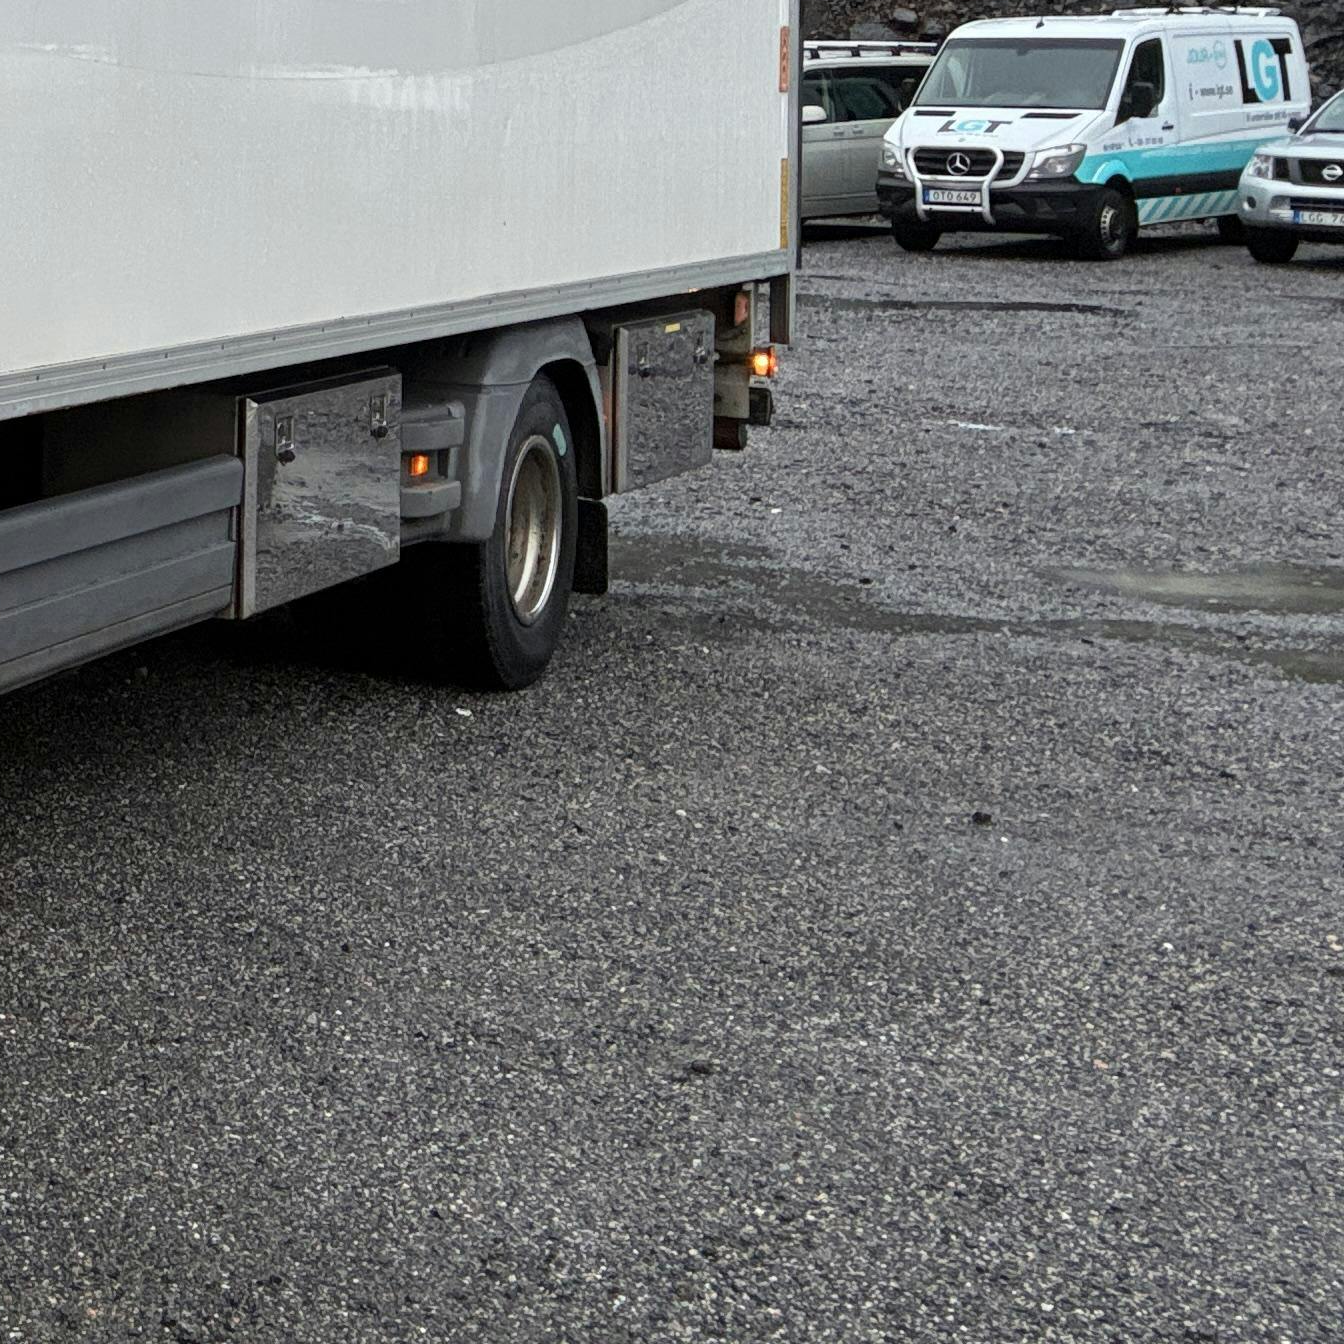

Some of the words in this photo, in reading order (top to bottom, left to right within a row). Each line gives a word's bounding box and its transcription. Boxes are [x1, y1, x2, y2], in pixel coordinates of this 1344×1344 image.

[1234, 38, 1292, 104] LGT
[937, 120, 1013, 133] LGT
[956, 192, 976, 202] 649
